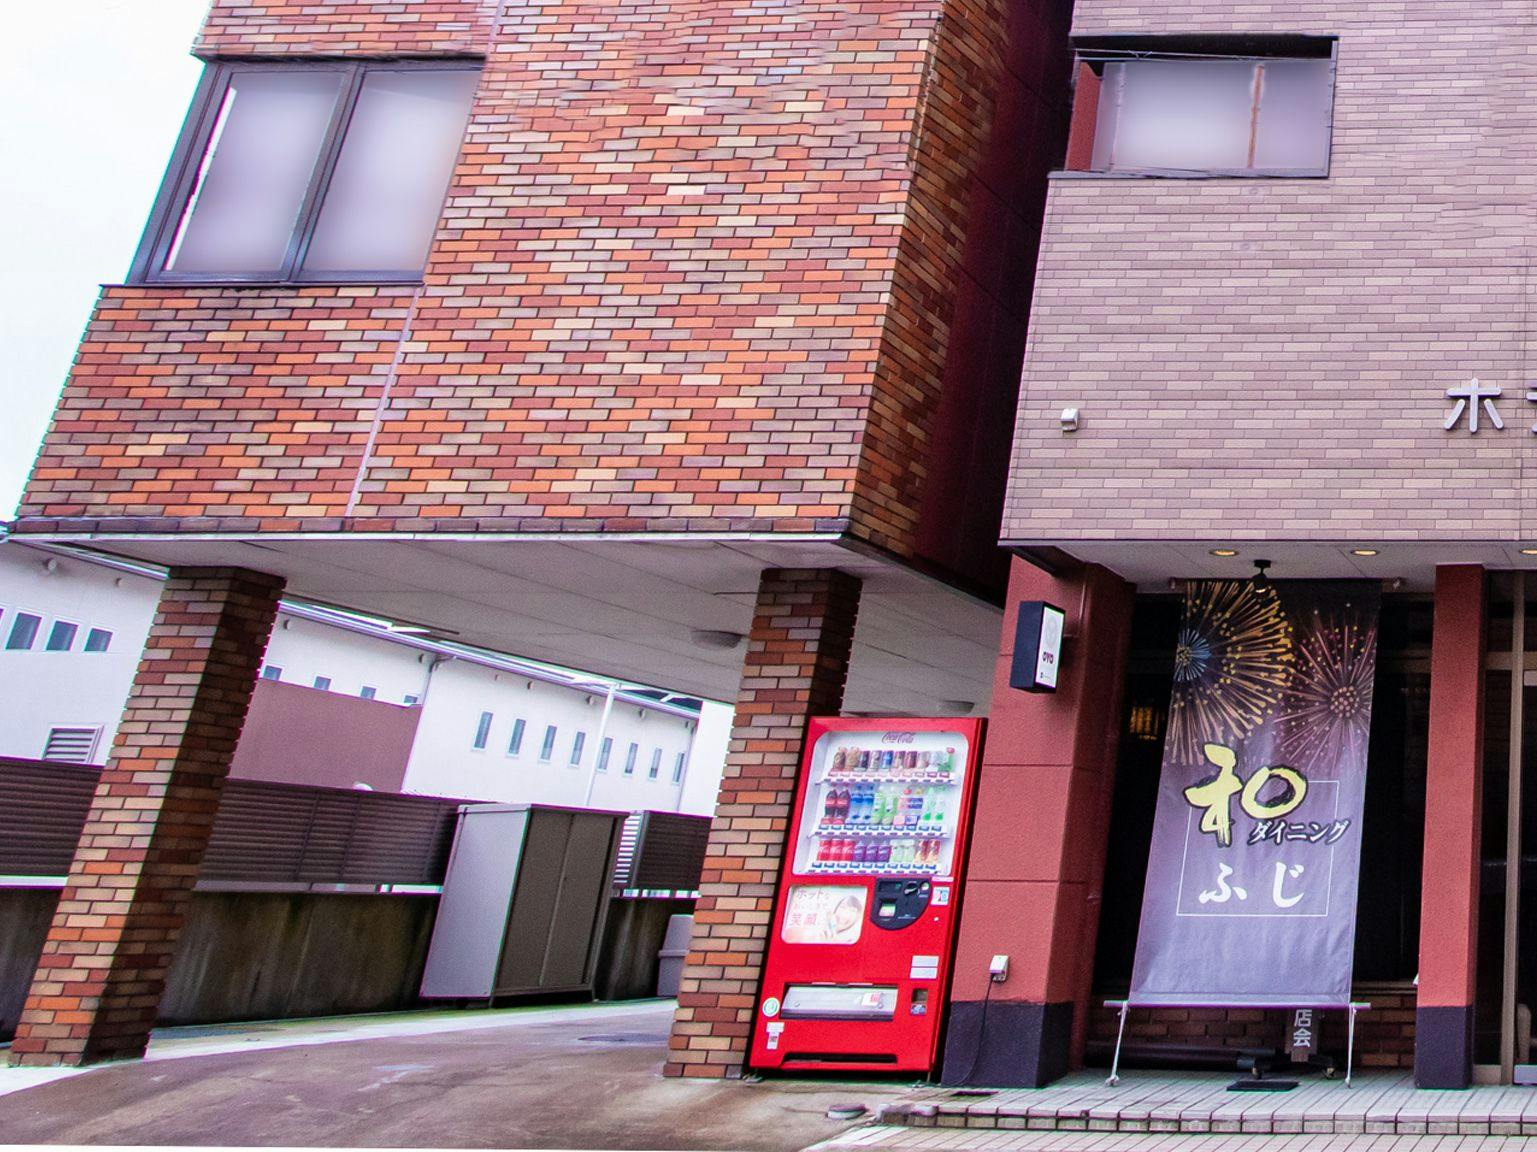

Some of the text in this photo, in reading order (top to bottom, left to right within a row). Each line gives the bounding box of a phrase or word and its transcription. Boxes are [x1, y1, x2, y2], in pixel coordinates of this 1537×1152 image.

[1184, 743, 1307, 847] 和
[1248, 820, 1352, 846] ダイニング
[1199, 862, 1304, 908] ふじ
